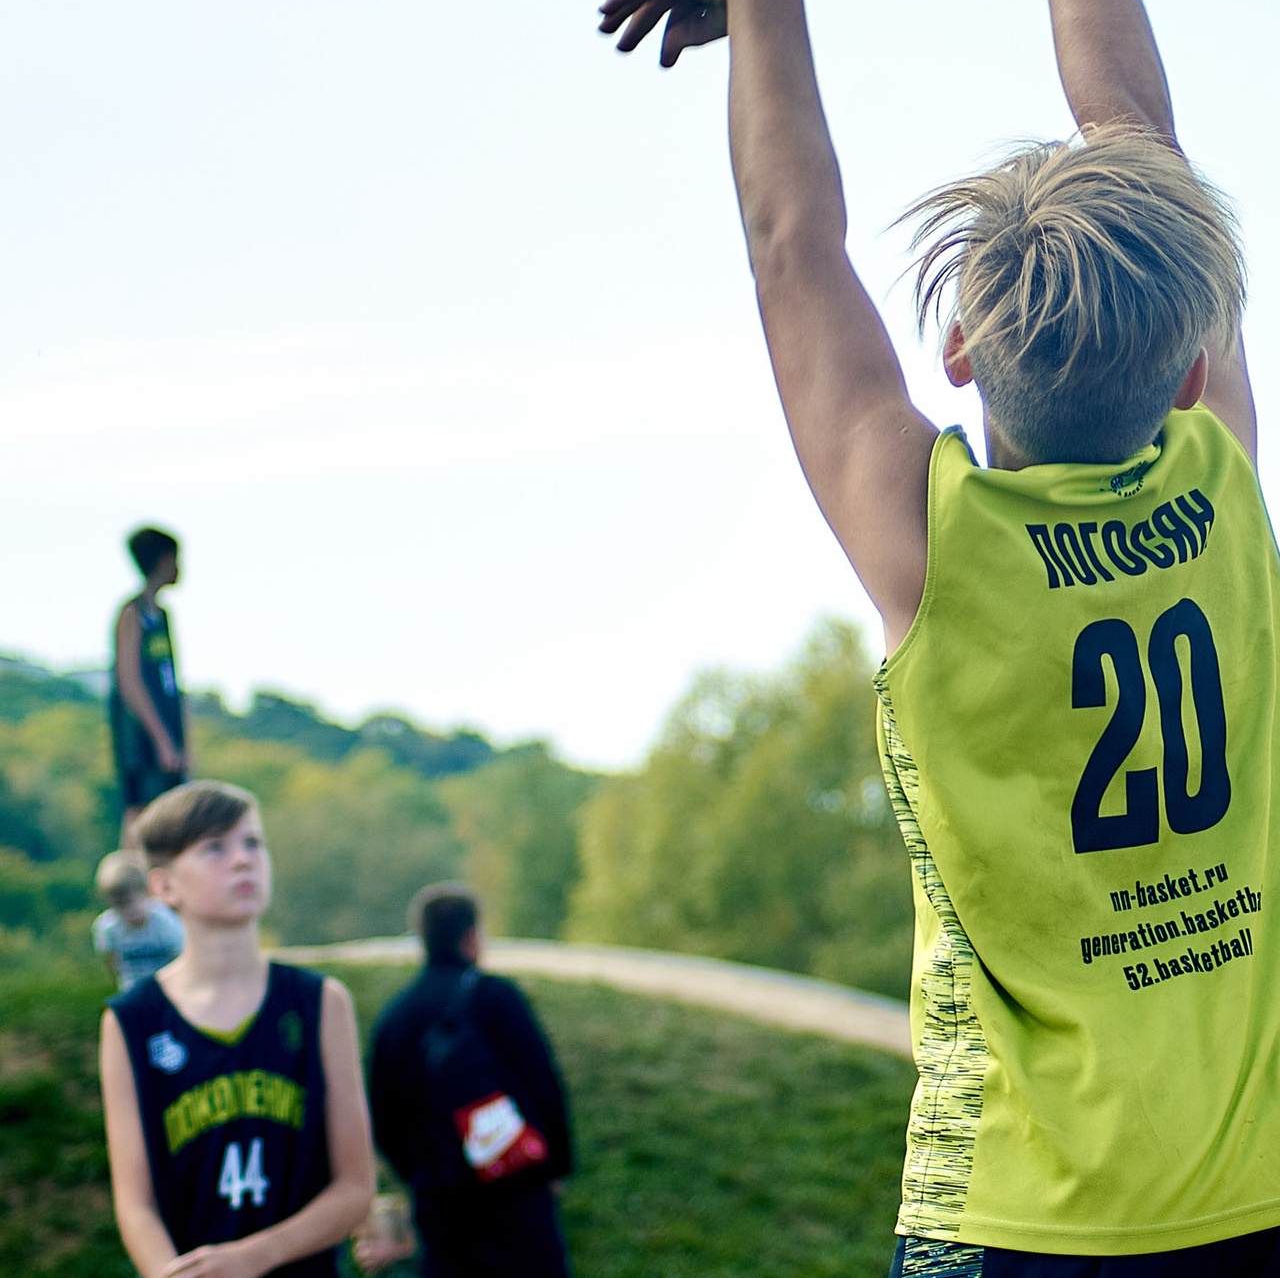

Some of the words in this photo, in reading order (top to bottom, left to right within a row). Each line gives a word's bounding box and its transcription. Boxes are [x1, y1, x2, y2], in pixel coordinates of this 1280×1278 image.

[1025, 488, 1215, 589] ПОГОСЯН
[1071, 598, 1231, 854] 20
[1110, 863, 1228, 912] nn-basket.ru
[1123, 928, 1253, 991] 52.basketball
[218, 1137, 268, 1208] 44
